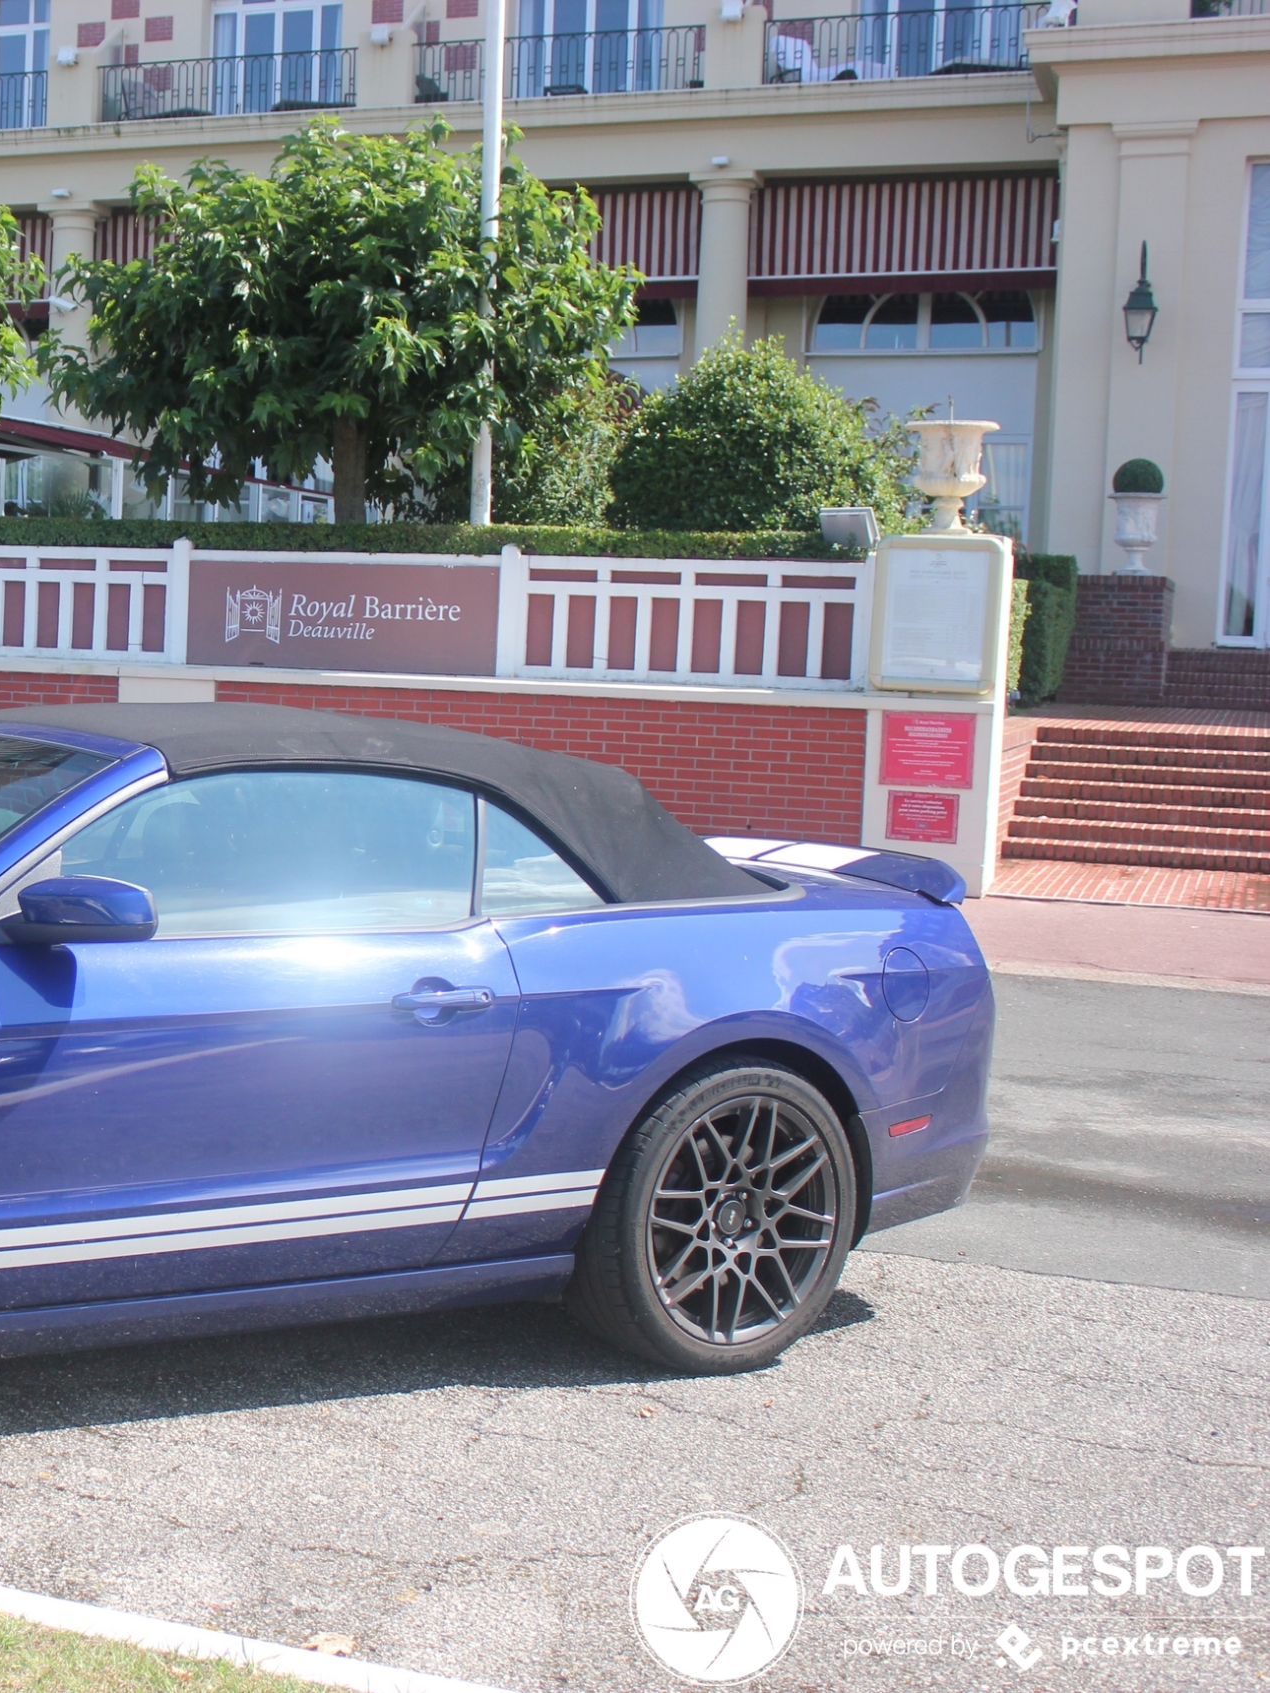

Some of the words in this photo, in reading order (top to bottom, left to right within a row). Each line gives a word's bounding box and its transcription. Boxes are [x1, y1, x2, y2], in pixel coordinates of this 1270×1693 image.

[288, 594, 355, 624] Royal
[363, 596, 461, 622] Barrière
[287, 619, 375, 640] Deauville
